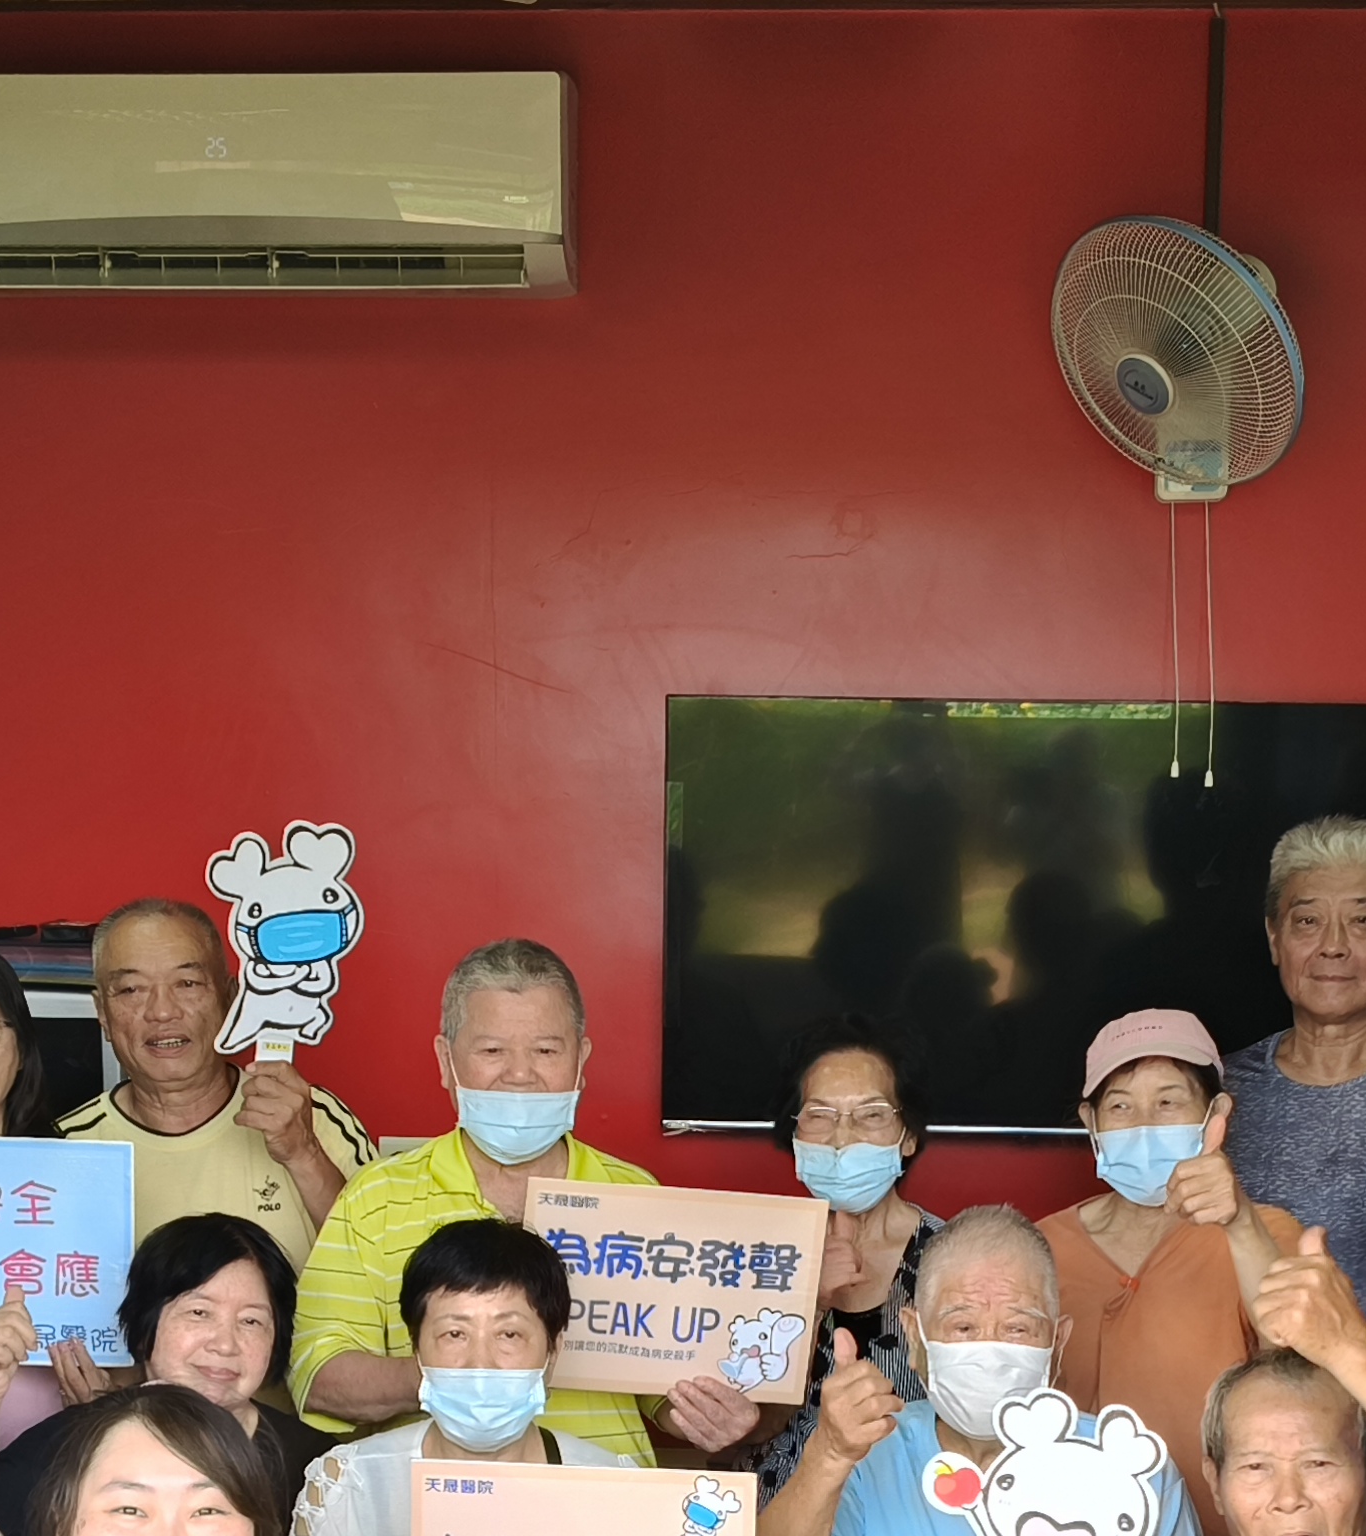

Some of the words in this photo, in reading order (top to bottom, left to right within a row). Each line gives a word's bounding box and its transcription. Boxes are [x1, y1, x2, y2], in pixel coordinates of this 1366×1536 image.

[205, 137, 227, 159] 25
[257, 1202, 282, 1212] POLO
[537, 1192, 600, 1209] 天晟醫院
[545, 1227, 803, 1293] 為病安發聲
[671, 1304, 721, 1344] UP
[563, 1339, 696, 1362] 別讓您的沉默成為病安殺手
[424, 1477, 494, 1495] 天晟醫院
